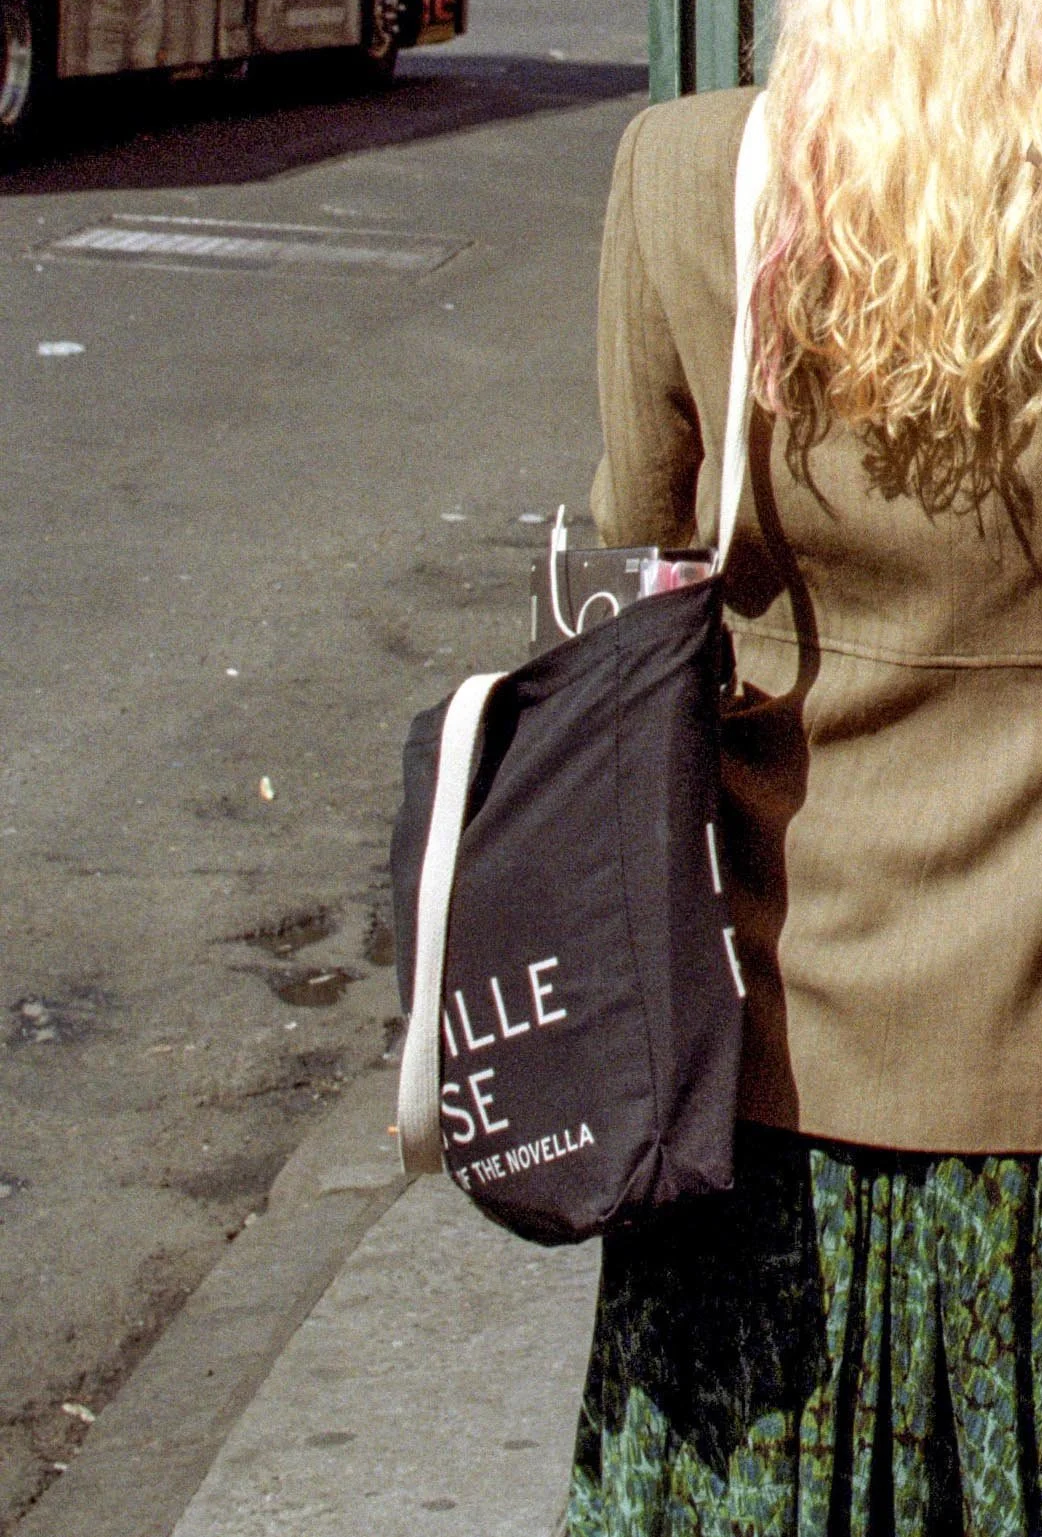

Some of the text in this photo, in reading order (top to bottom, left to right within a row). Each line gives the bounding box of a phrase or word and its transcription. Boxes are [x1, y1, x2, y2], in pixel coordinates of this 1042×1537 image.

[442, 1067, 509, 1151] SE
[471, 1154, 507, 1184] THE
[505, 1122, 596, 1174] NOVELLA
